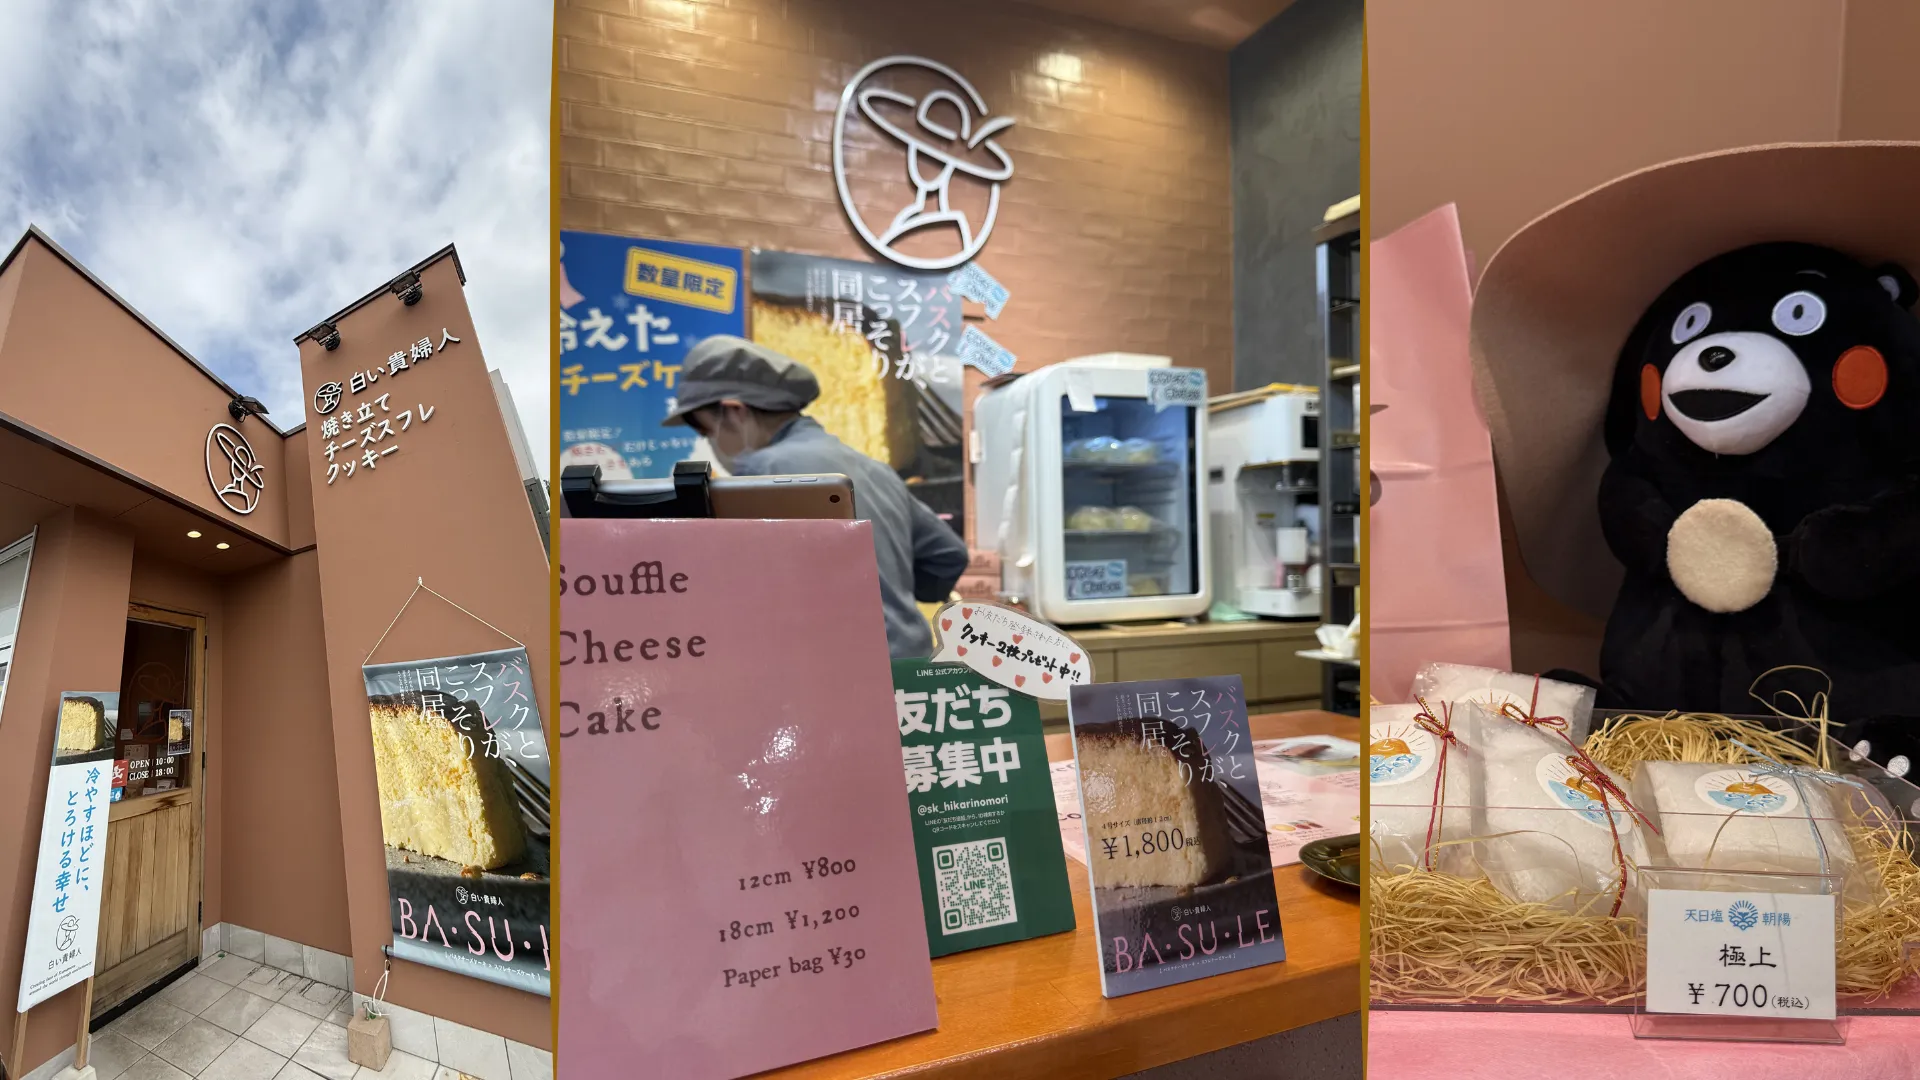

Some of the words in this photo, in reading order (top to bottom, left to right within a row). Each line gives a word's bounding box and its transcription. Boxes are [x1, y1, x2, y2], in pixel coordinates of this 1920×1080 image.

[636, 260, 725, 300] 数量限定
[866, 275, 894, 380] こっそり
[349, 327, 461, 395] 白い貴婦人
[321, 392, 391, 440] 焼き立て
[324, 403, 436, 463] チーズスフレ
[326, 444, 399, 485] クッキー
[560, 629, 707, 666] Cheese
[916, 669, 934, 677] LINE
[445, 665, 475, 760] こっそり
[470, 661, 517, 768] スフレが、
[496, 656, 540, 759] バスクと
[560, 697, 662, 738] Cake
[895, 684, 1012, 736] 友だち
[1166, 691, 1194, 787] こっそり
[1190, 689, 1228, 789] スフレが、
[1215, 686, 1246, 780] バスクと
[129, 770, 149, 781] CLOSE
[155, 766, 174, 777] 18:00
[130, 759, 150, 769] OPEN
[156, 756, 174, 766] 10:00
[902, 736, 1021, 793] 募集中
[917, 794, 1009, 816] @sk_hikarinomori
[75, 767, 101, 891] 冷やすほどに、
[52, 790, 79, 913] とろける幸せ
[738, 869, 792, 891] 12cm
[802, 856, 856, 880] ¥800
[963, 879, 987, 891] LINE
[470, 893, 505, 907] 白い貴婦人
[1183, 905, 1212, 917] 白い貴婦人
[1684, 908, 1724, 923] 天日塩
[1762, 912, 1791, 927] 朝陽
[719, 919, 774, 942] 18cm
[784, 905, 860, 930] ¥1,200
[48, 948, 82, 970] 白い貴婦人
[722, 964, 781, 988] Paper
[788, 956, 824, 974] bag
[827, 947, 866, 969] ¥30
[1719, 944, 1777, 968] 極上
